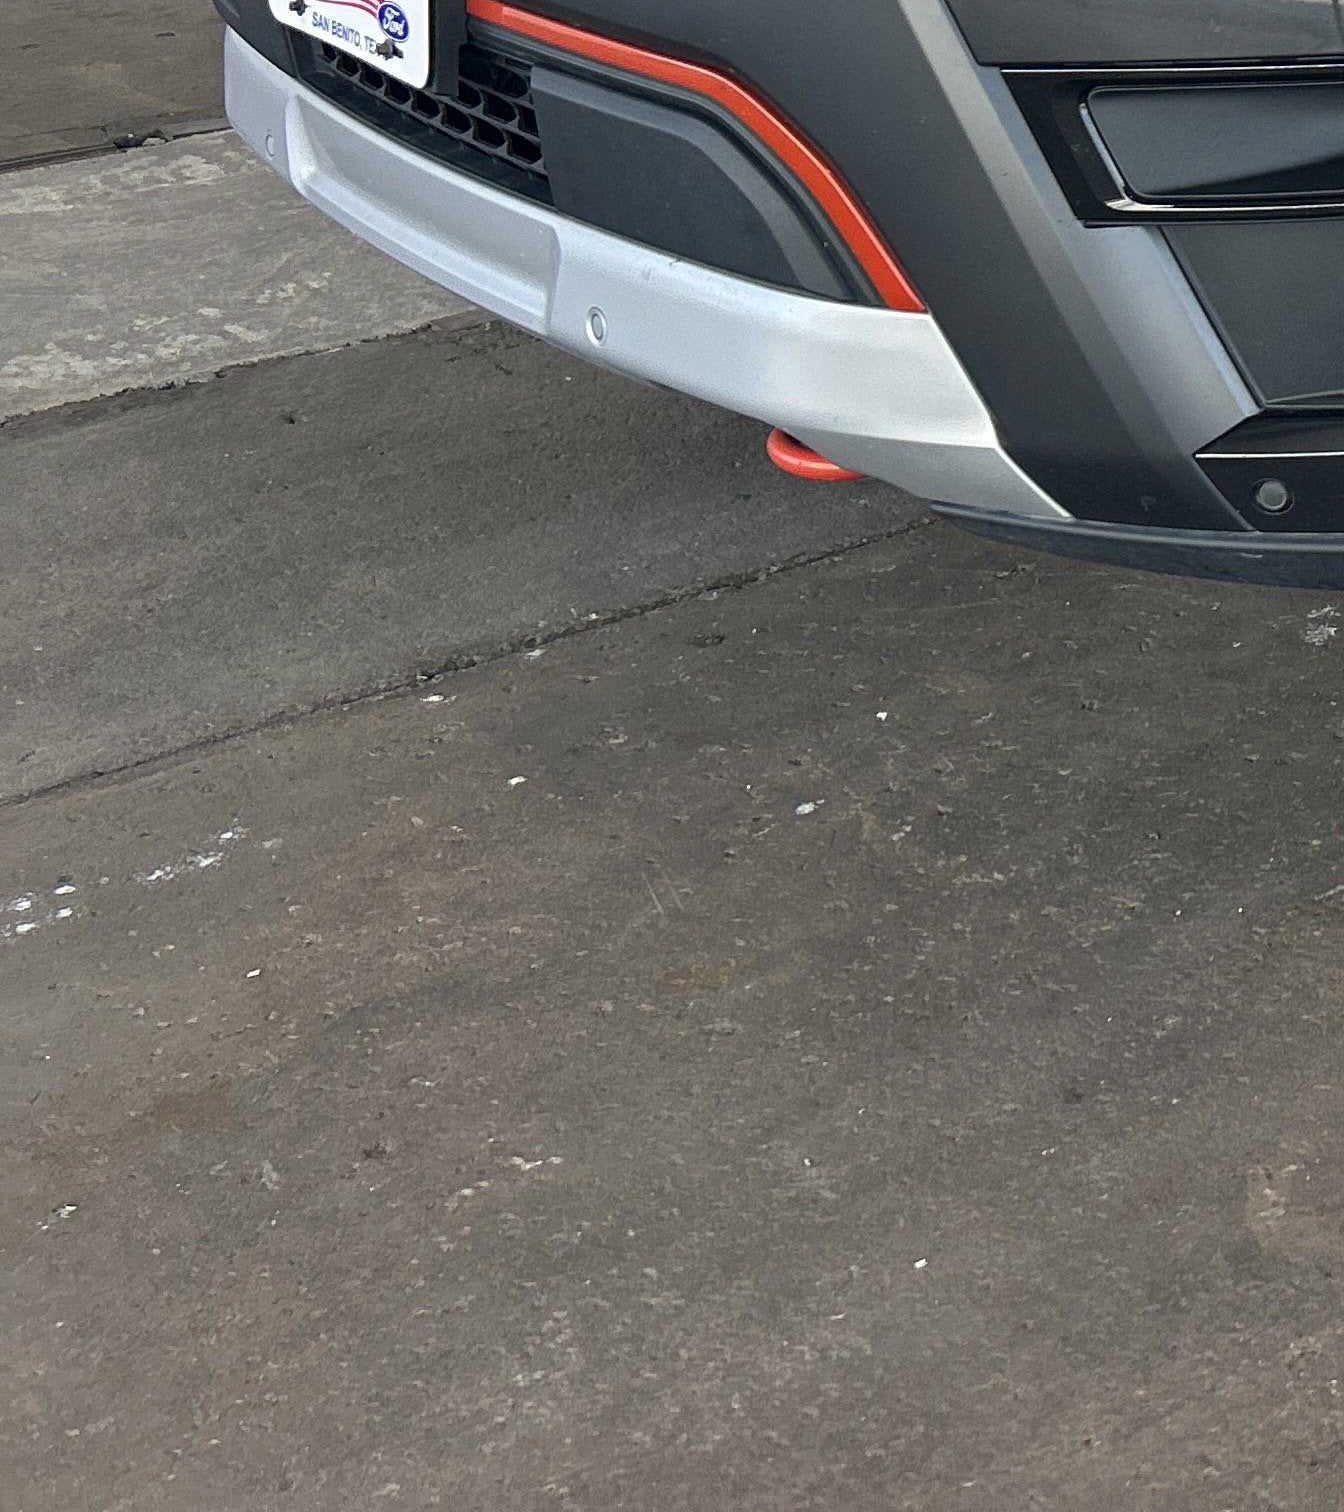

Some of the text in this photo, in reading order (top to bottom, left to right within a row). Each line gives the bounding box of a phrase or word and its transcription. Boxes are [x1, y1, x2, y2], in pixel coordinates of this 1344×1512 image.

[312, 11, 330, 32] SAN
[331, 20, 362, 50] BENITO,
[383, 6, 406, 36] Ford
